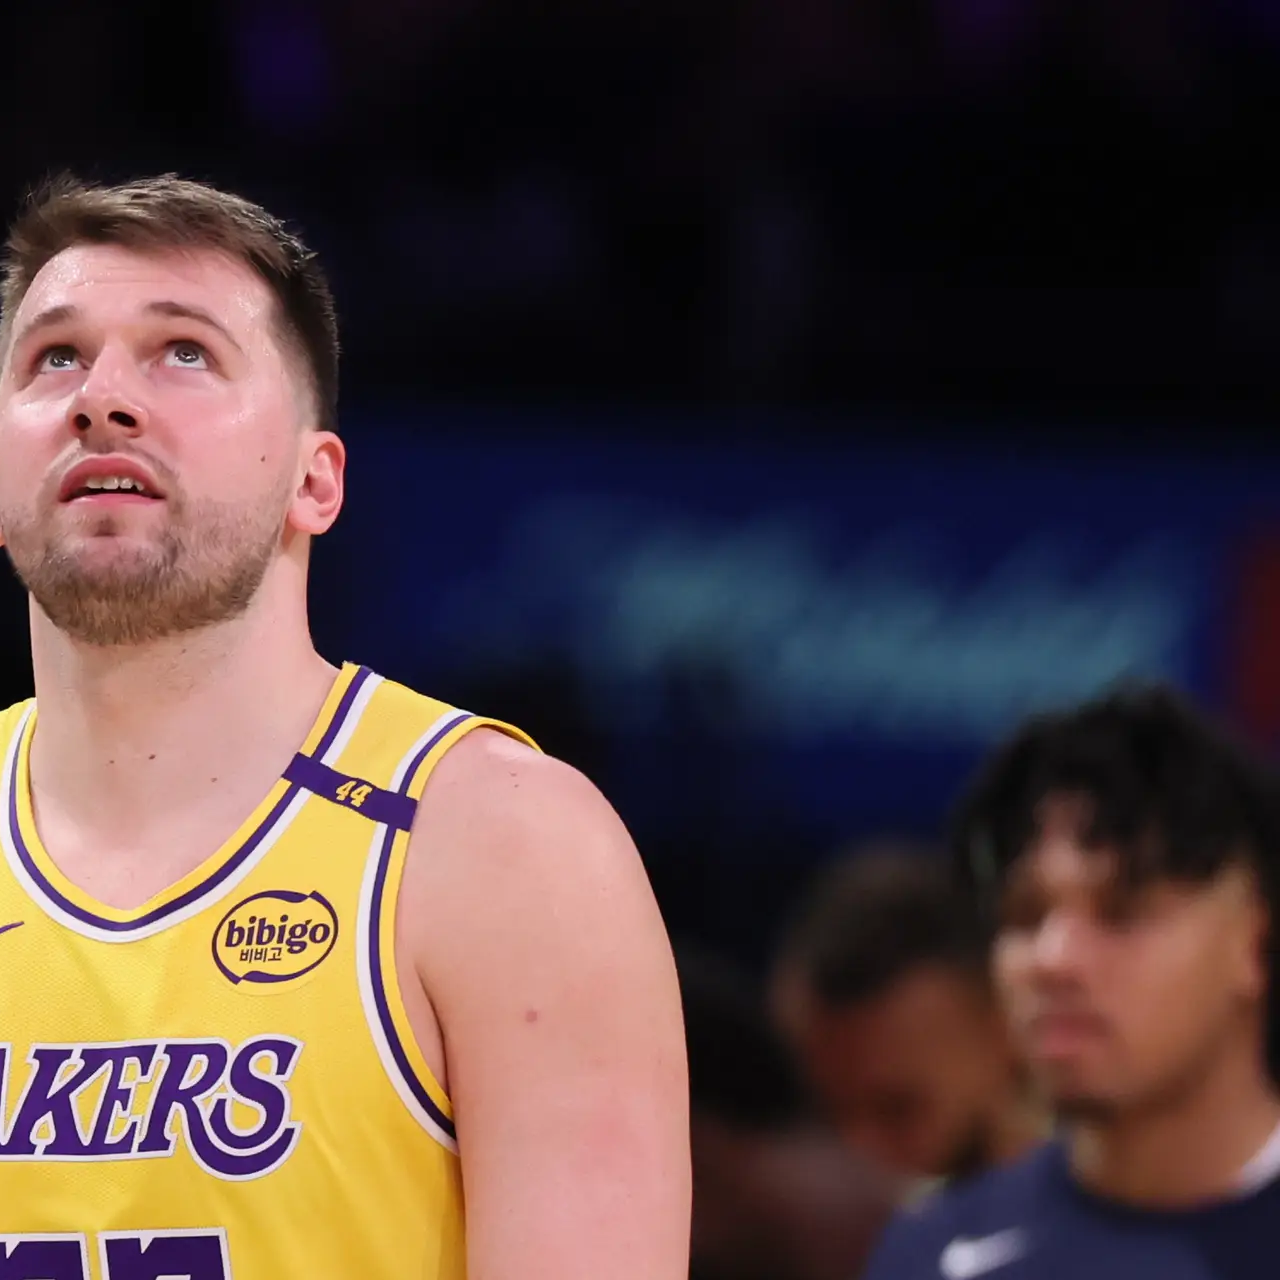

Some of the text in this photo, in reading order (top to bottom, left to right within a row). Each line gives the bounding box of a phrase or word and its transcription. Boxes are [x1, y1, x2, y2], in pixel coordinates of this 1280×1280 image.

[335, 780, 373, 807] 44
[224, 914, 330, 954] bibigo
[239, 947, 282, 963] 비비고
